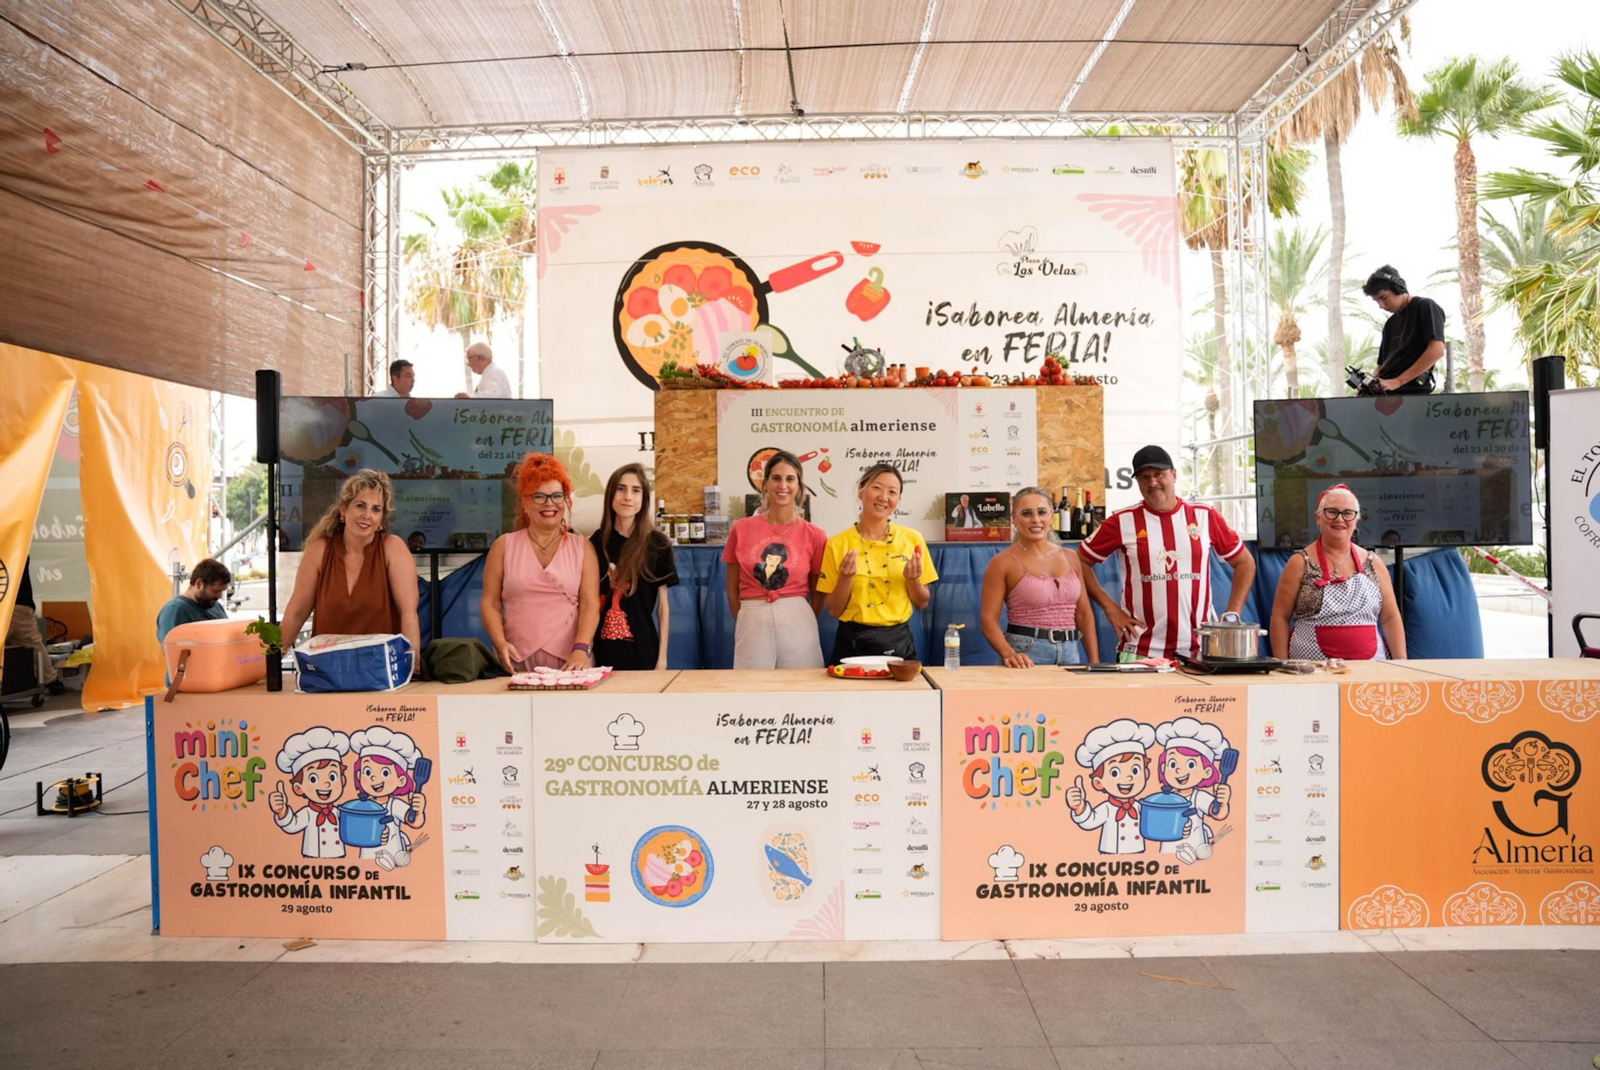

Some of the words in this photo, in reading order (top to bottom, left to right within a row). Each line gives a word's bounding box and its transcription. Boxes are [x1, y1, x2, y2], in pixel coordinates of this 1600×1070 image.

[729, 166, 760, 176] eco
[1014, 262, 1034, 278] Las
[1038, 260, 1077, 276] Velas
[1054, 302, 1154, 328] Almería
[961, 346, 993, 364] en
[1002, 331, 1112, 364] FERIA!
[751, 408, 763, 417] III
[765, 407, 830, 417] ENCUENTRO
[832, 408, 844, 416] DE
[750, 420, 848, 433] GASTRONOMÍA
[850, 420, 936, 432] almeriense
[1450, 428, 1470, 440] en
[475, 435, 495, 447] en
[478, 451, 492, 460] del
[506, 451, 514, 460] al
[896, 448, 938, 458] Almería
[1454, 444, 1468, 454] del
[1484, 444, 1492, 453] al
[1582, 440, 1600, 462] TO
[1570, 468, 1588, 484] EL
[976, 503, 1006, 512] Lobello
[1194, 704, 1225, 714] FERIA!
[386, 712, 415, 722] FERIA!
[782, 714, 836, 726] Almería
[174, 720, 248, 759] mini
[734, 734, 750, 746] en
[755, 728, 812, 746] FERIA!
[964, 713, 1046, 755] mini
[578, 754, 694, 772] CONCURSO
[696, 754, 720, 772] de
[545, 776, 704, 796] GASTRONOMÍA
[706, 780, 828, 796] ALMERIENSE
[1257, 786, 1281, 795] eco
[451, 796, 476, 804] eco
[854, 793, 880, 802] eco
[746, 800, 760, 810] 27
[762, 802, 770, 812] y
[772, 800, 786, 809] 28
[788, 799, 828, 812] agosto
[1472, 828, 1594, 864] Almería
[238, 864, 255, 879] IX
[262, 864, 360, 880] CONCURSO
[365, 870, 380, 880] DE
[1029, 863, 1048, 878] IX
[1056, 860, 1160, 878] CONCURSO
[1164, 864, 1180, 875] DE
[190, 880, 323, 898] GASTRONOMÍA
[330, 884, 411, 900] INFANTIL
[976, 878, 1119, 899] GASTRONOMÍA
[1126, 878, 1211, 896] INFANTIL
[281, 904, 294, 914] 29
[296, 904, 333, 916] agosto
[1074, 902, 1088, 912] 29
[1090, 900, 1129, 914] agosto
